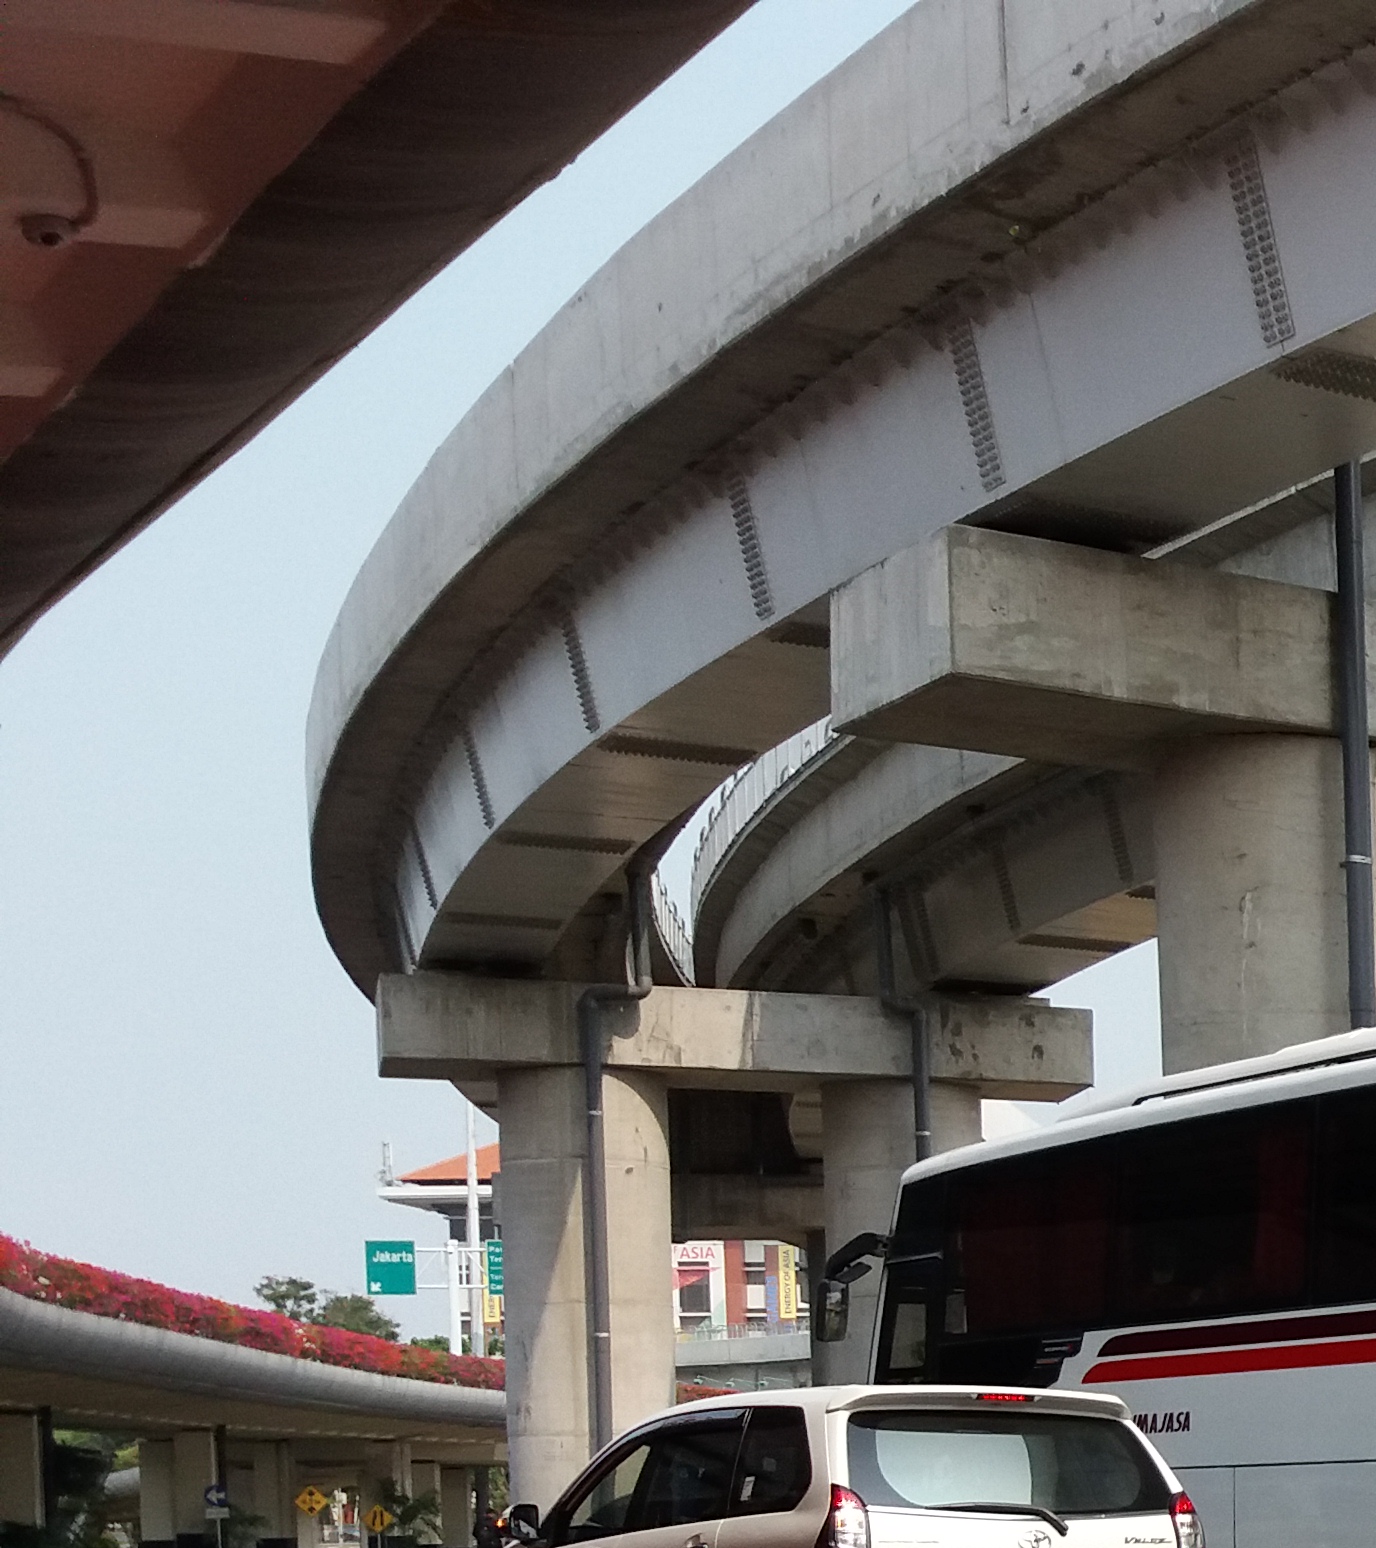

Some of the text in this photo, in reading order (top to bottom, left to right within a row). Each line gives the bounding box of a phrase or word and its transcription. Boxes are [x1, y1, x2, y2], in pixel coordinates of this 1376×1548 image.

[372, 1250, 414, 1264] Jakarta
[680, 1246, 716, 1259] ASIA
[782, 1249, 792, 1314] ENERGY OF ASIA
